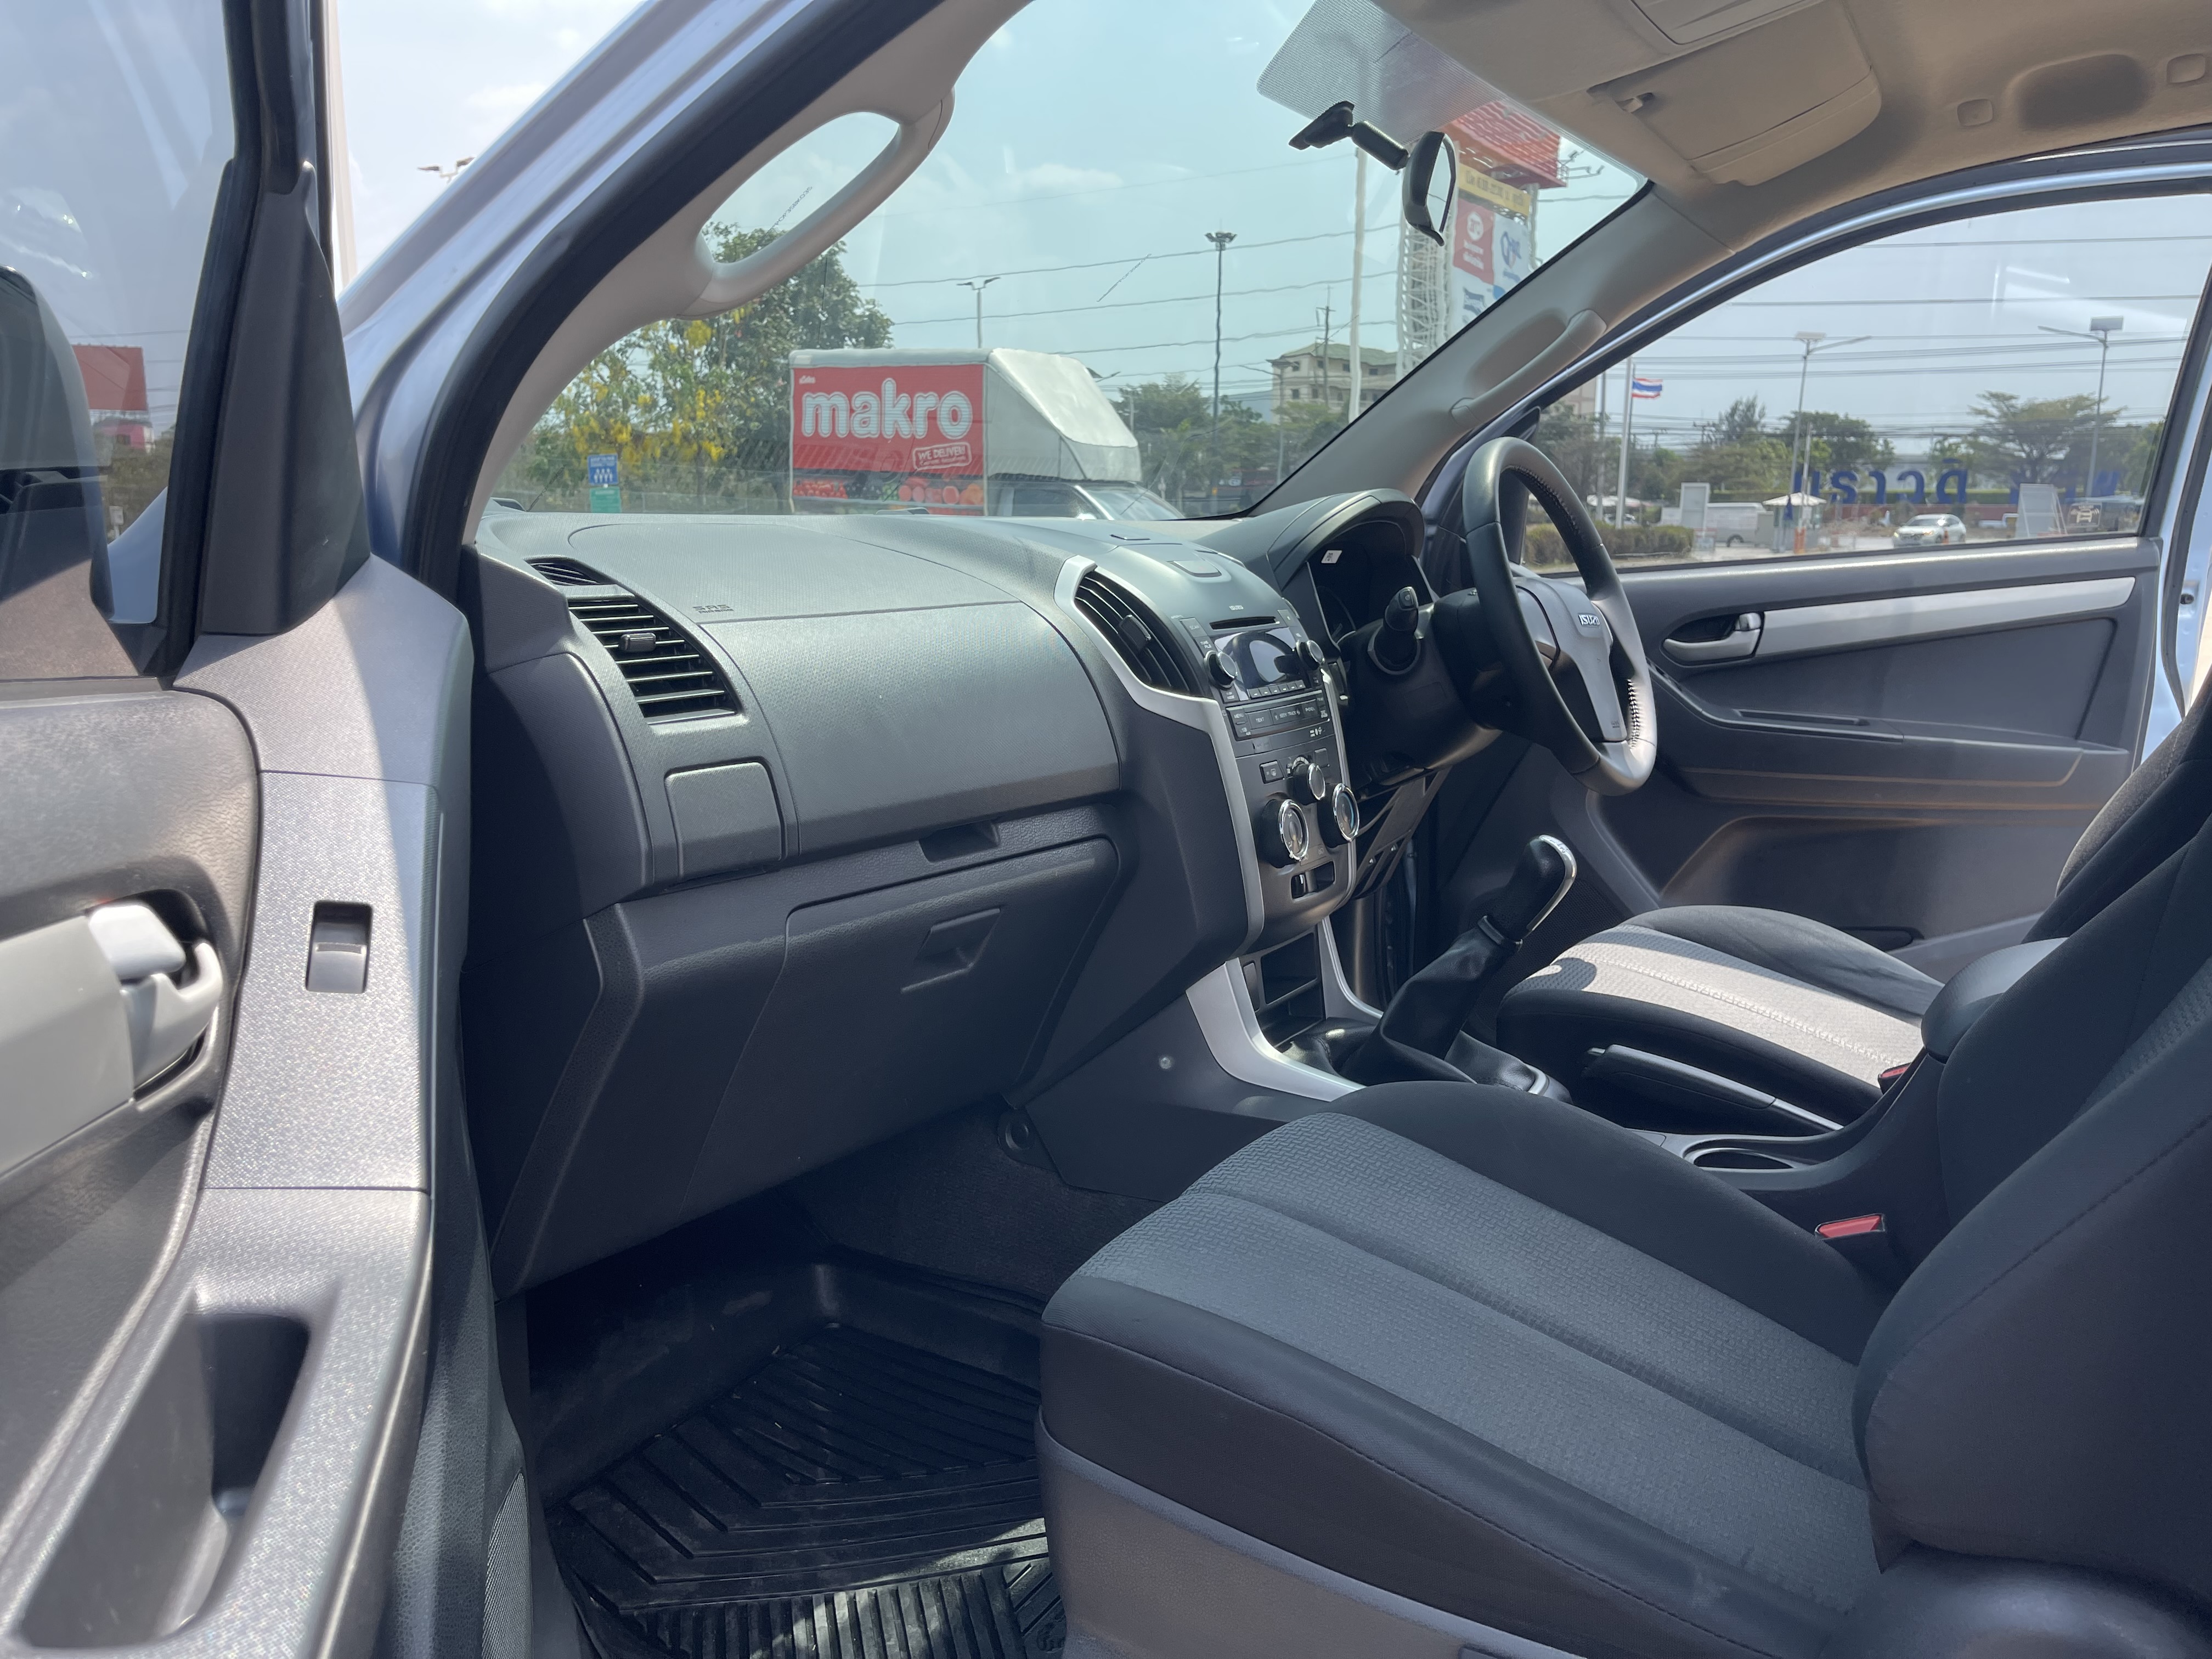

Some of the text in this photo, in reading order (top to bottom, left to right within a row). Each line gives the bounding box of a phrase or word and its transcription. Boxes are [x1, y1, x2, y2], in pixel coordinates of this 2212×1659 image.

[801, 377, 973, 440] makro
[917, 450, 932, 460] WE
[1578, 614, 1600, 626] ISUZU
